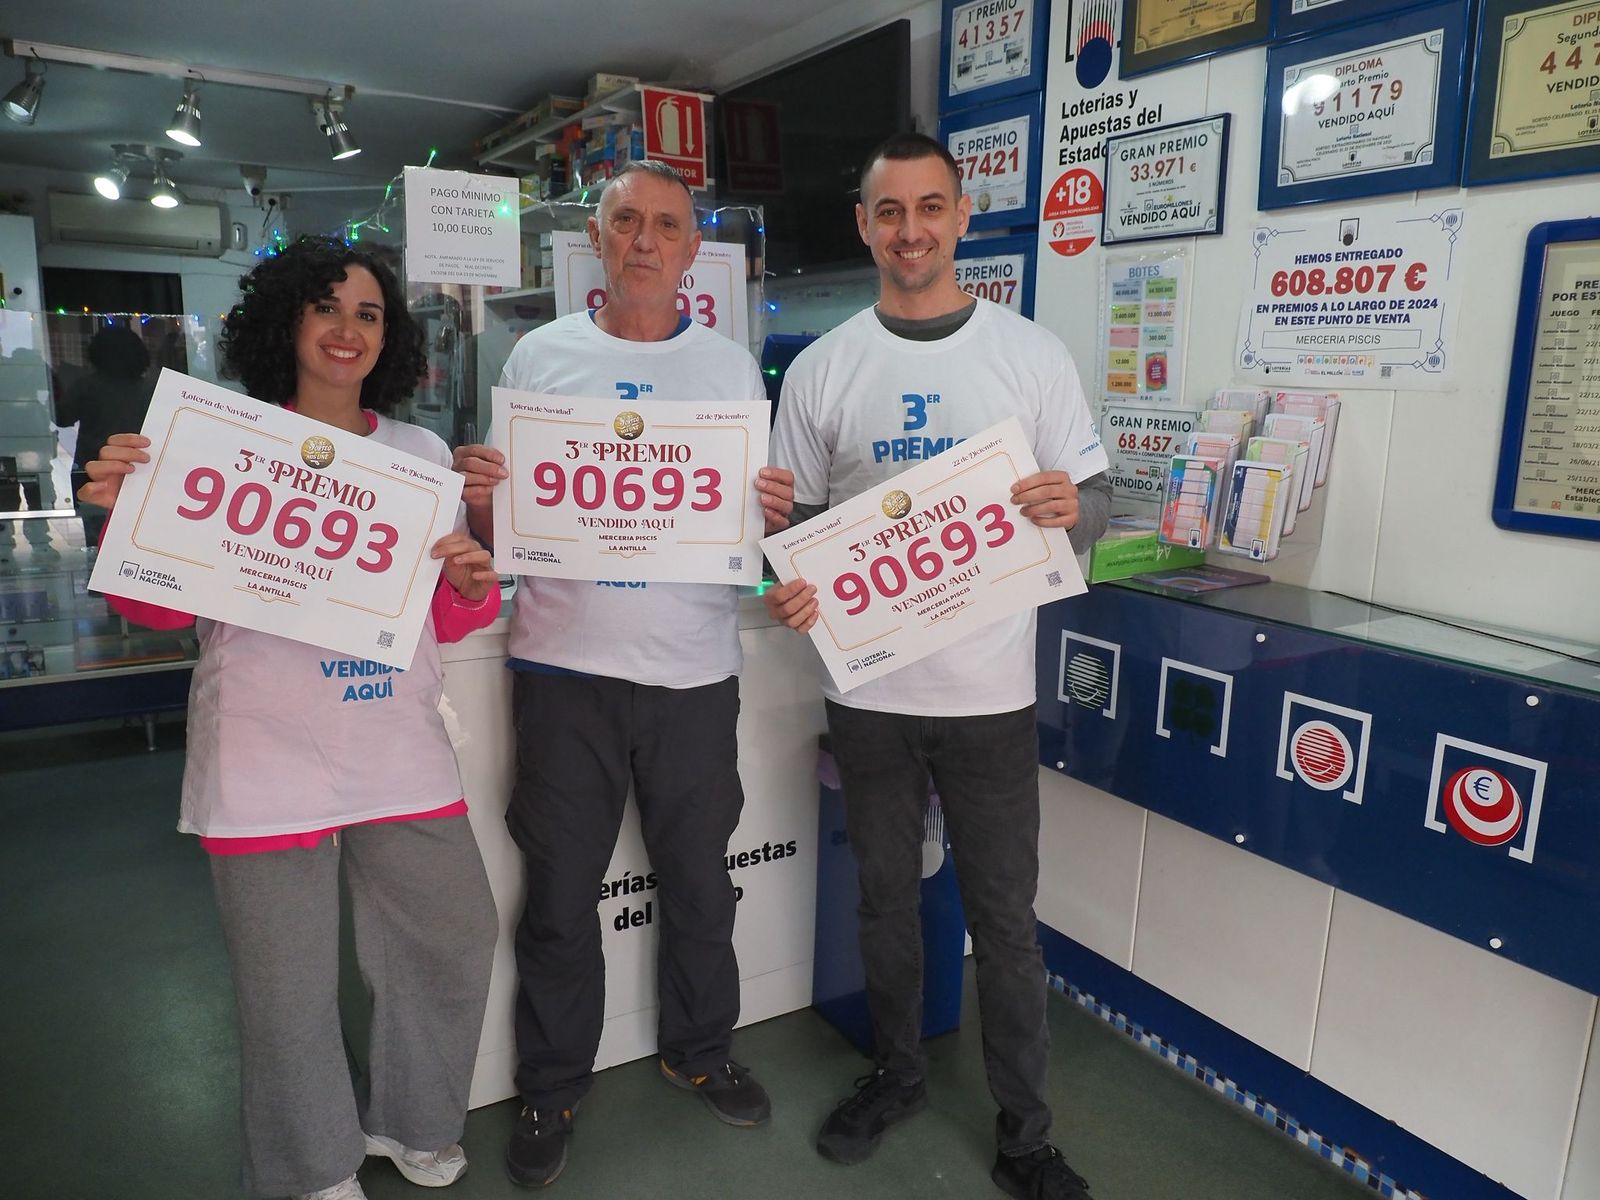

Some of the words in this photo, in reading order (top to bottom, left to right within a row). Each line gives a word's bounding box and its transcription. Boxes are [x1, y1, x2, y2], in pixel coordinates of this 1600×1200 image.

[977, 0, 1017, 21] PREMIO
[959, 10, 1024, 48] 41357
[1557, 26, 1600, 45] Segund
[1335, 57, 1383, 77] DIPLOMA
[1358, 70, 1389, 83] Premio
[1129, 89, 1138, 110] y
[1060, 114, 1131, 145] Apuestas
[1137, 104, 1162, 128] del
[1318, 112, 1365, 129] VENDIDO
[1367, 104, 1395, 121] AQUÍ
[968, 131, 1017, 154] PREMIO
[1120, 144, 1155, 162] GRAN
[1160, 134, 1208, 155] PREMIO
[1130, 156, 1184, 183] 33.971
[1190, 162, 1196, 173] €
[430, 188, 459, 198] PAGO
[461, 191, 501, 203] MINIMO
[1056, 175, 1091, 206] +18
[431, 205, 453, 215] CON
[456, 208, 495, 219] TARJETA
[1120, 210, 1167, 227] VENDIDO
[1171, 202, 1201, 219] AQUÍ
[1154, 200, 1193, 211] EUROMILLONES
[432, 223, 459, 234] 10,00
[461, 225, 493, 236] EUROS
[1295, 253, 1332, 265] HEMOS
[1335, 248, 1404, 262] ENTREGADO
[965, 264, 1013, 280] PREMIO
[1129, 265, 1160, 278] BOTES
[1271, 264, 1396, 297] 608.807
[1404, 262, 1428, 292] €
[1256, 304, 1270, 314] EN
[1272, 302, 1319, 313] PREMIOS
[1320, 302, 1329, 312] A
[1330, 301, 1345, 312] LO
[1348, 300, 1387, 312] LARGO
[1389, 300, 1406, 310] DE
[1407, 298, 1438, 310] 2024
[1552, 293, 1577, 302] POR
[586, 289, 717, 329] 993
[1275, 316, 1289, 326] EN
[1291, 316, 1316, 326] ESTE
[1318, 315, 1354, 326] PUNTO
[1356, 314, 1372, 325] DE
[1374, 313, 1411, 324] VENTA
[1295, 335, 1346, 345] MERCERIA
[1348, 334, 1382, 345] PISCIS
[214, 402, 225, 412] de
[225, 404, 263, 423] Navidad
[543, 407, 574, 416] Navidad
[695, 413, 704, 421] 22
[705, 413, 713, 421] de
[714, 413, 750, 421] Diciembre
[1110, 415, 1143, 429] GRAN
[1147, 418, 1192, 433] PREMIO
[592, 442, 692, 464] PREMIO
[872, 437, 968, 464] PREMI
[952, 459, 960, 468] 22
[961, 456, 969, 465] de
[969, 437, 1004, 461] Diciembre
[1118, 433, 1173, 453] 68.457
[268, 459, 377, 513] PREMIO
[390, 462, 401, 472] 22
[400, 466, 409, 476] de
[408, 469, 445, 489] Diciembre
[1108, 476, 1153, 492] VENDIDO
[533, 461, 723, 513] 90693
[176, 467, 400, 574] 90693
[577, 516, 638, 530] VENDIDO
[641, 516, 675, 532] AQUÍ
[806, 533, 815, 542] de
[815, 516, 843, 537] Navidad
[873, 494, 967, 550] PREMIO
[598, 534, 635, 542] MERCERIA
[221, 538, 291, 571] VENDIDO
[295, 559, 334, 582] AQUÍ
[527, 549, 555, 559] LOTERÍA
[527, 556, 562, 564] NACIONAL
[832, 503, 1016, 617] 90693
[1157, 546, 1172, 561] A4
[138, 575, 184, 593] NACIONAL
[140, 568, 177, 584] LOTERÍA
[239, 566, 282, 584] MERCERIA
[282, 577, 308, 591] PISCIS
[247, 581, 258, 591] LA
[258, 583, 292, 600] ANTILLA
[891, 582, 947, 615] VENDIDO
[949, 564, 982, 587] AQUÍ
[917, 596, 950, 617] MERCERIA
[949, 586, 971, 601] PISCIS
[930, 612, 940, 622] LA
[940, 600, 966, 619] ANTILLA
[861, 649, 888, 665] LOTERÍA
[863, 651, 896, 668] NACIONAL
[320, 660, 406, 678] VENDID
[342, 676, 393, 702] AQUÍ
[599, 870, 659, 901] erías
[613, 902, 653, 932] del
